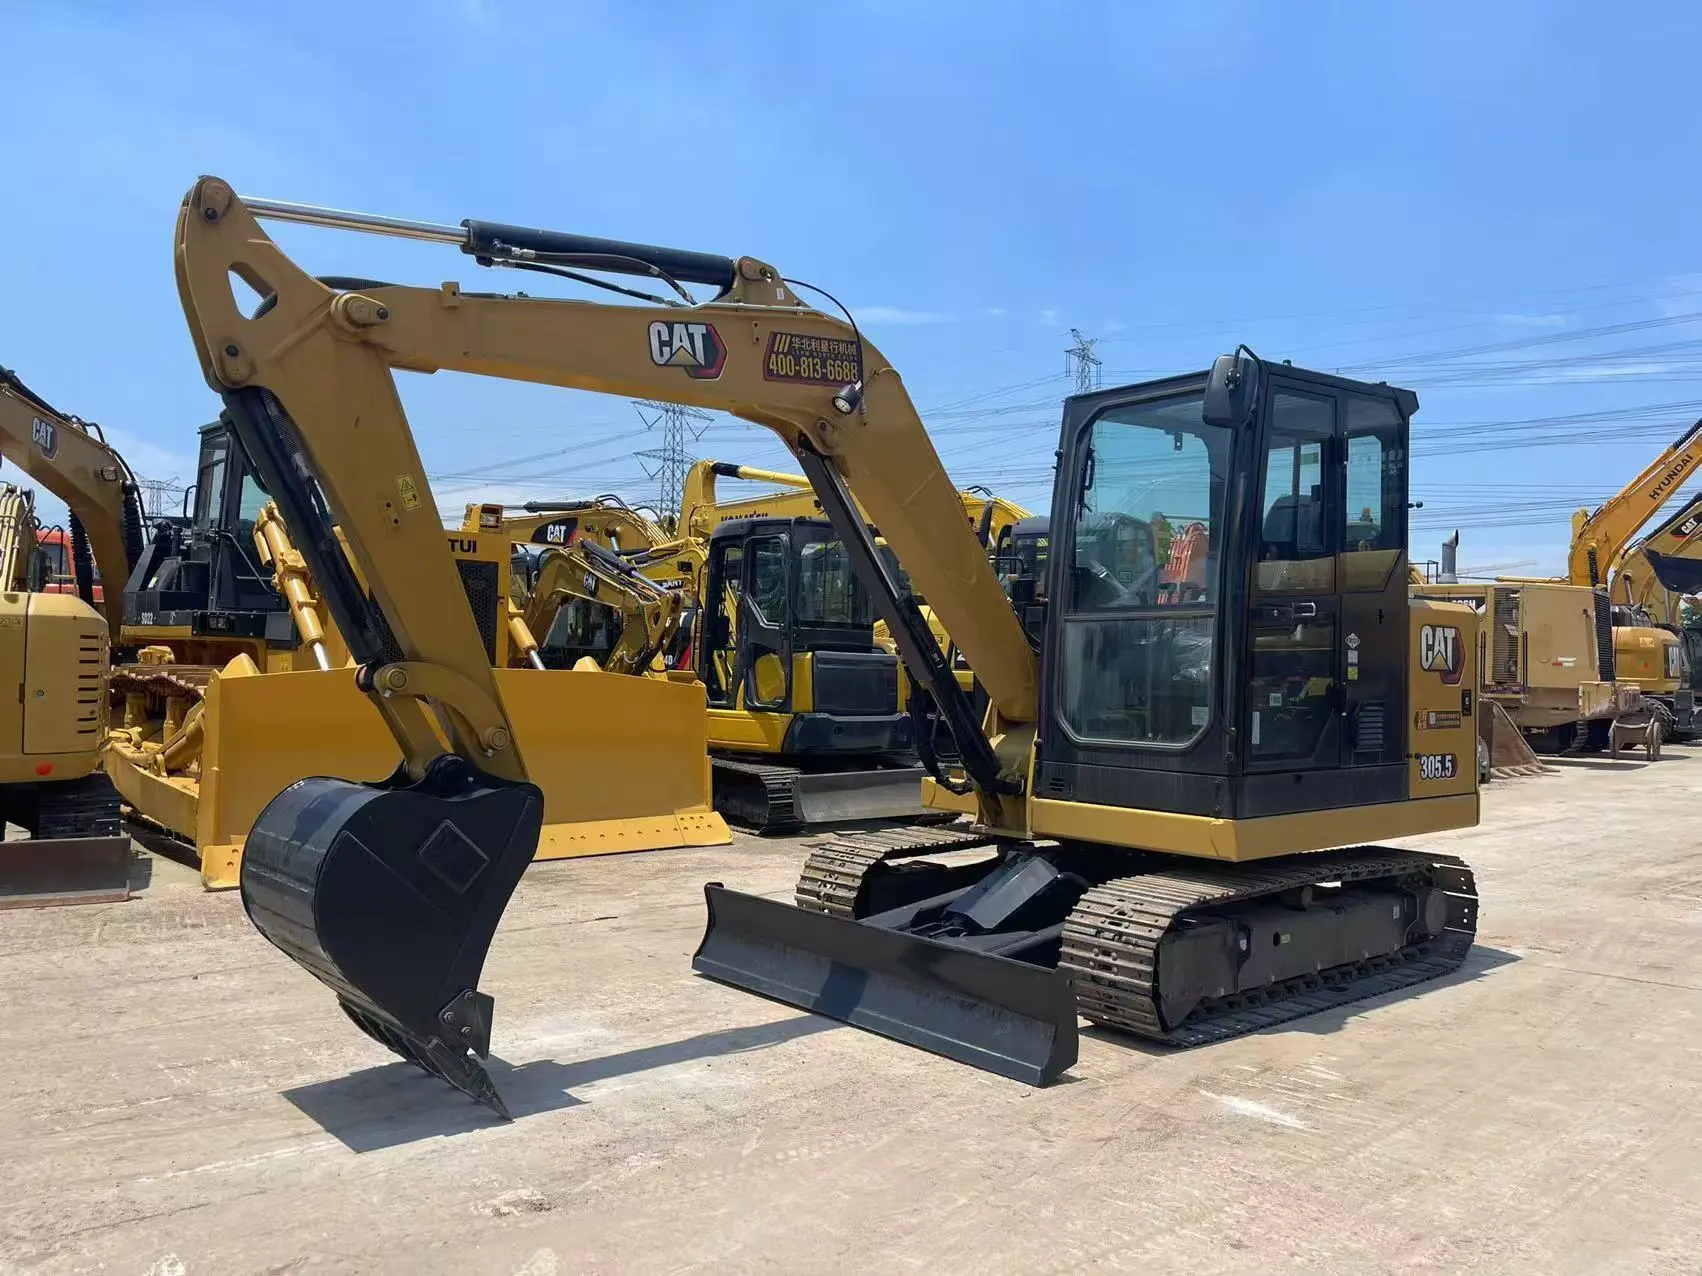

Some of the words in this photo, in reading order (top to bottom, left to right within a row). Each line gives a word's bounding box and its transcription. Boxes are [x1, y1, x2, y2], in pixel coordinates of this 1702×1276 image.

[650, 321, 707, 366] CAT
[769, 353, 859, 382] 400-813-6688
[32, 417, 53, 449] CAT
[1649, 453, 1693, 500] HYUNDAI
[547, 524, 566, 543] CAT
[1681, 517, 1698, 534] CAT
[1421, 625, 1456, 671] CAT
[1421, 755, 1452, 778] 305.5
